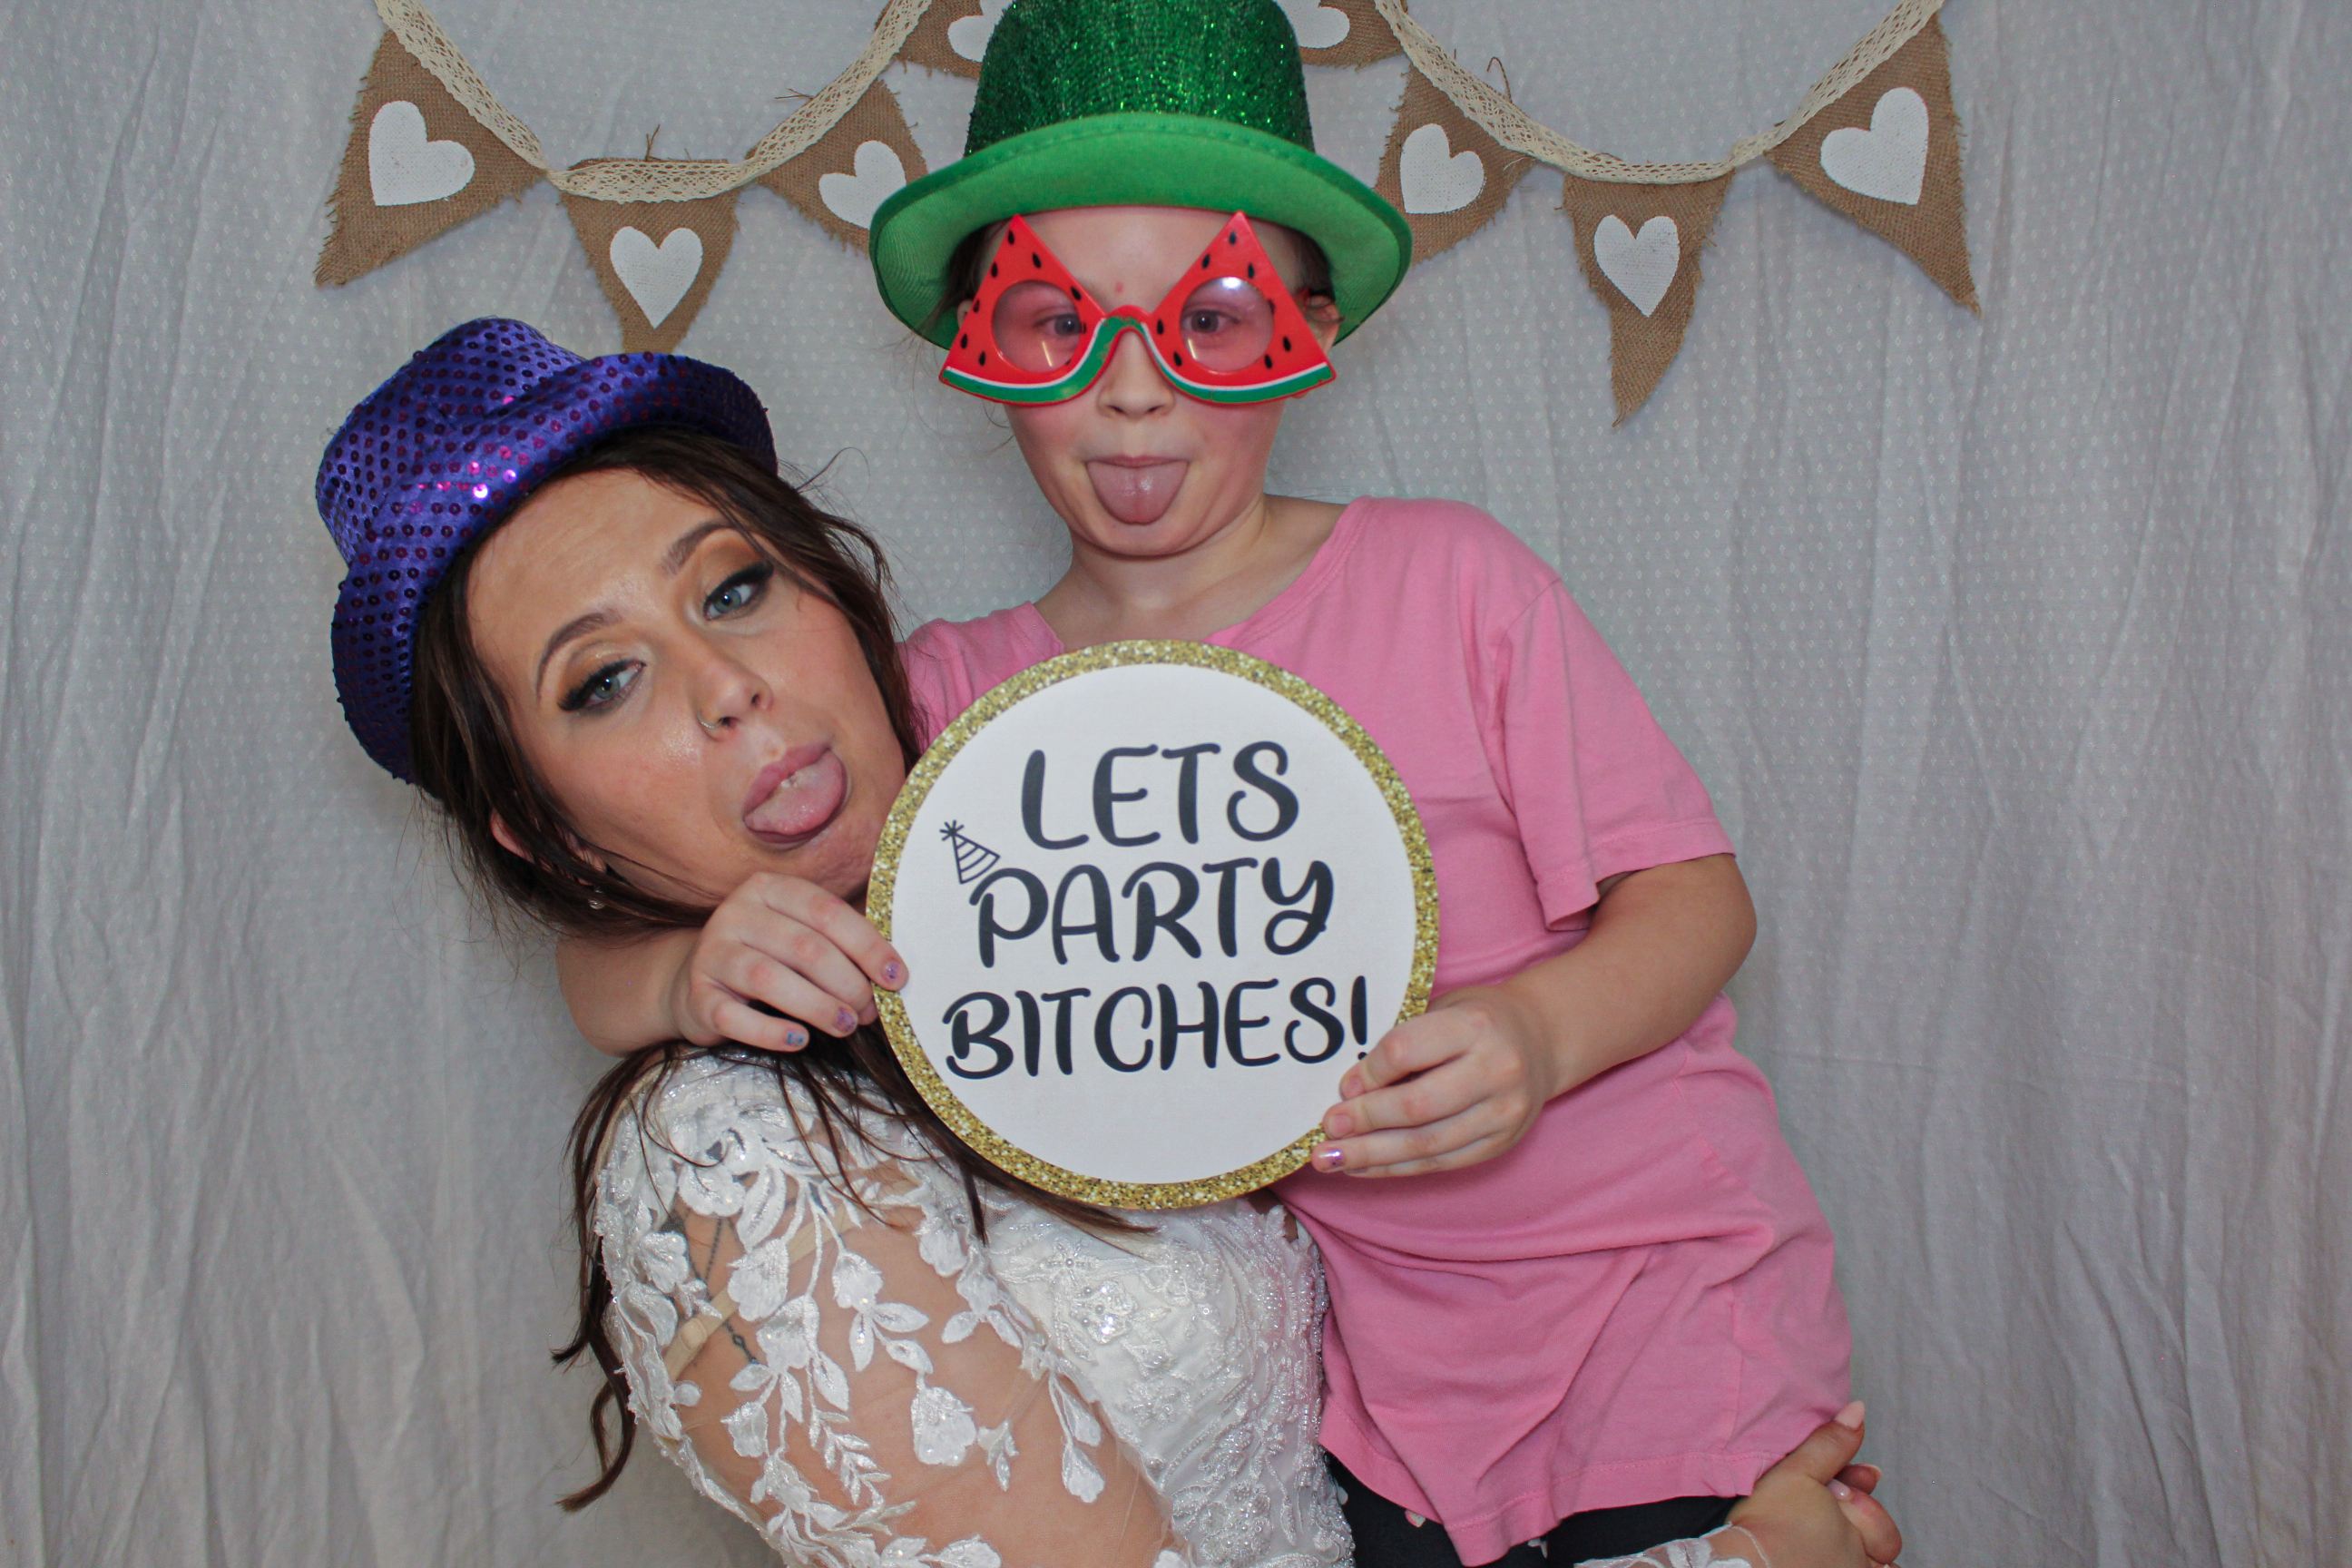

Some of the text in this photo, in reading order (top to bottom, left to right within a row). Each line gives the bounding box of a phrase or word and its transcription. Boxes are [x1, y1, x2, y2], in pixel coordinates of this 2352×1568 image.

[1021, 740, 1299, 849] LETS
[970, 857, 1334, 968] PARTY
[943, 975, 1368, 1080] BITCHES!
